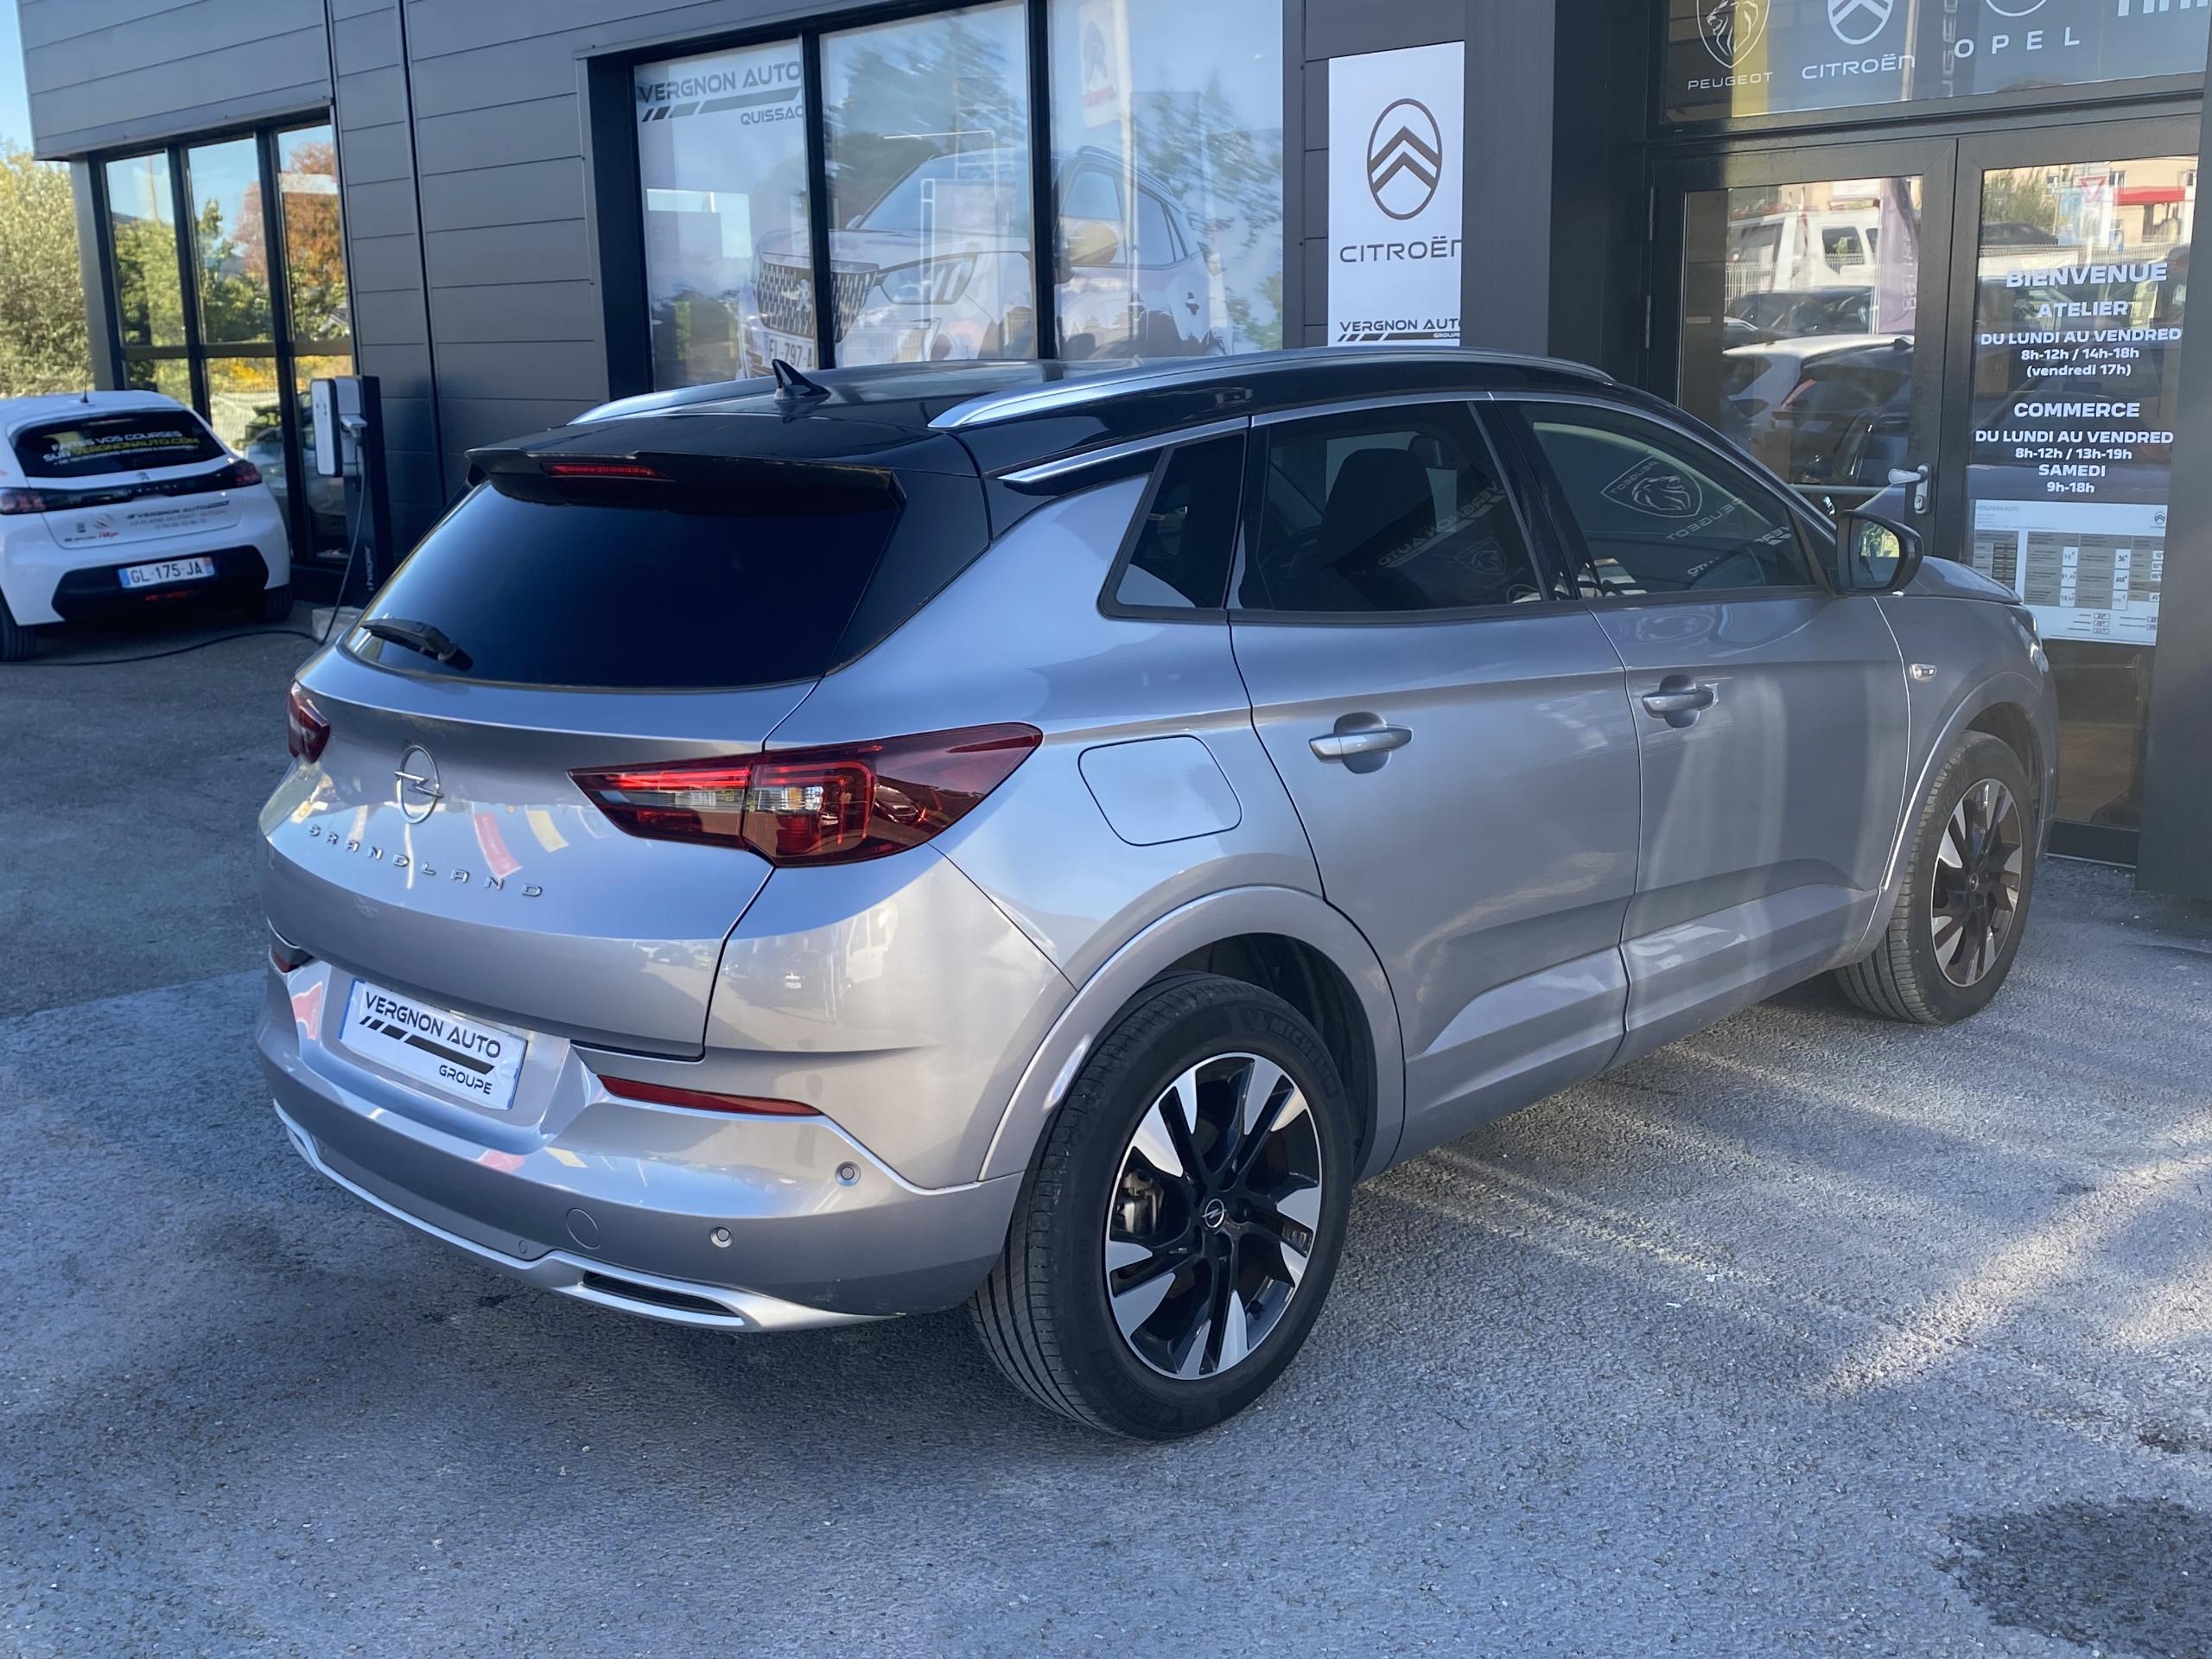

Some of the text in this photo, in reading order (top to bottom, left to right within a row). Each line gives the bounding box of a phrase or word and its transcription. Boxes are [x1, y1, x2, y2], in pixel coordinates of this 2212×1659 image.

[1955, 27, 2080, 58] OPEL
[639, 61, 802, 103] VERGNON AUTO
[1688, 72, 1774, 90] PEUGEOT
[2006, 263, 2168, 288] BIENVENUE
[2037, 301, 2128, 318] ATELIER
[1339, 318, 1460, 332] VERGNON AUT
[1980, 328, 2183, 346] DU LUNDI AU VENDRED
[2021, 347, 2139, 361] 8h-12h / 14h-18h
[2026, 364, 2132, 378] (vendredi 17h)
[2014, 403, 2140, 418] COMMERCE
[1975, 430, 2174, 444] DU LUNDI AU VENDRED
[2015, 448, 2133, 460] 8h-12h / 13h-19h
[2039, 464, 2106, 477] SAMEDI
[2047, 482, 2095, 493] 9h-18h
[308, 823, 543, 898] GRANDLAND
[365, 992, 501, 1058] VERGNON AUTO
[439, 1065, 493, 1095] GROUPE
